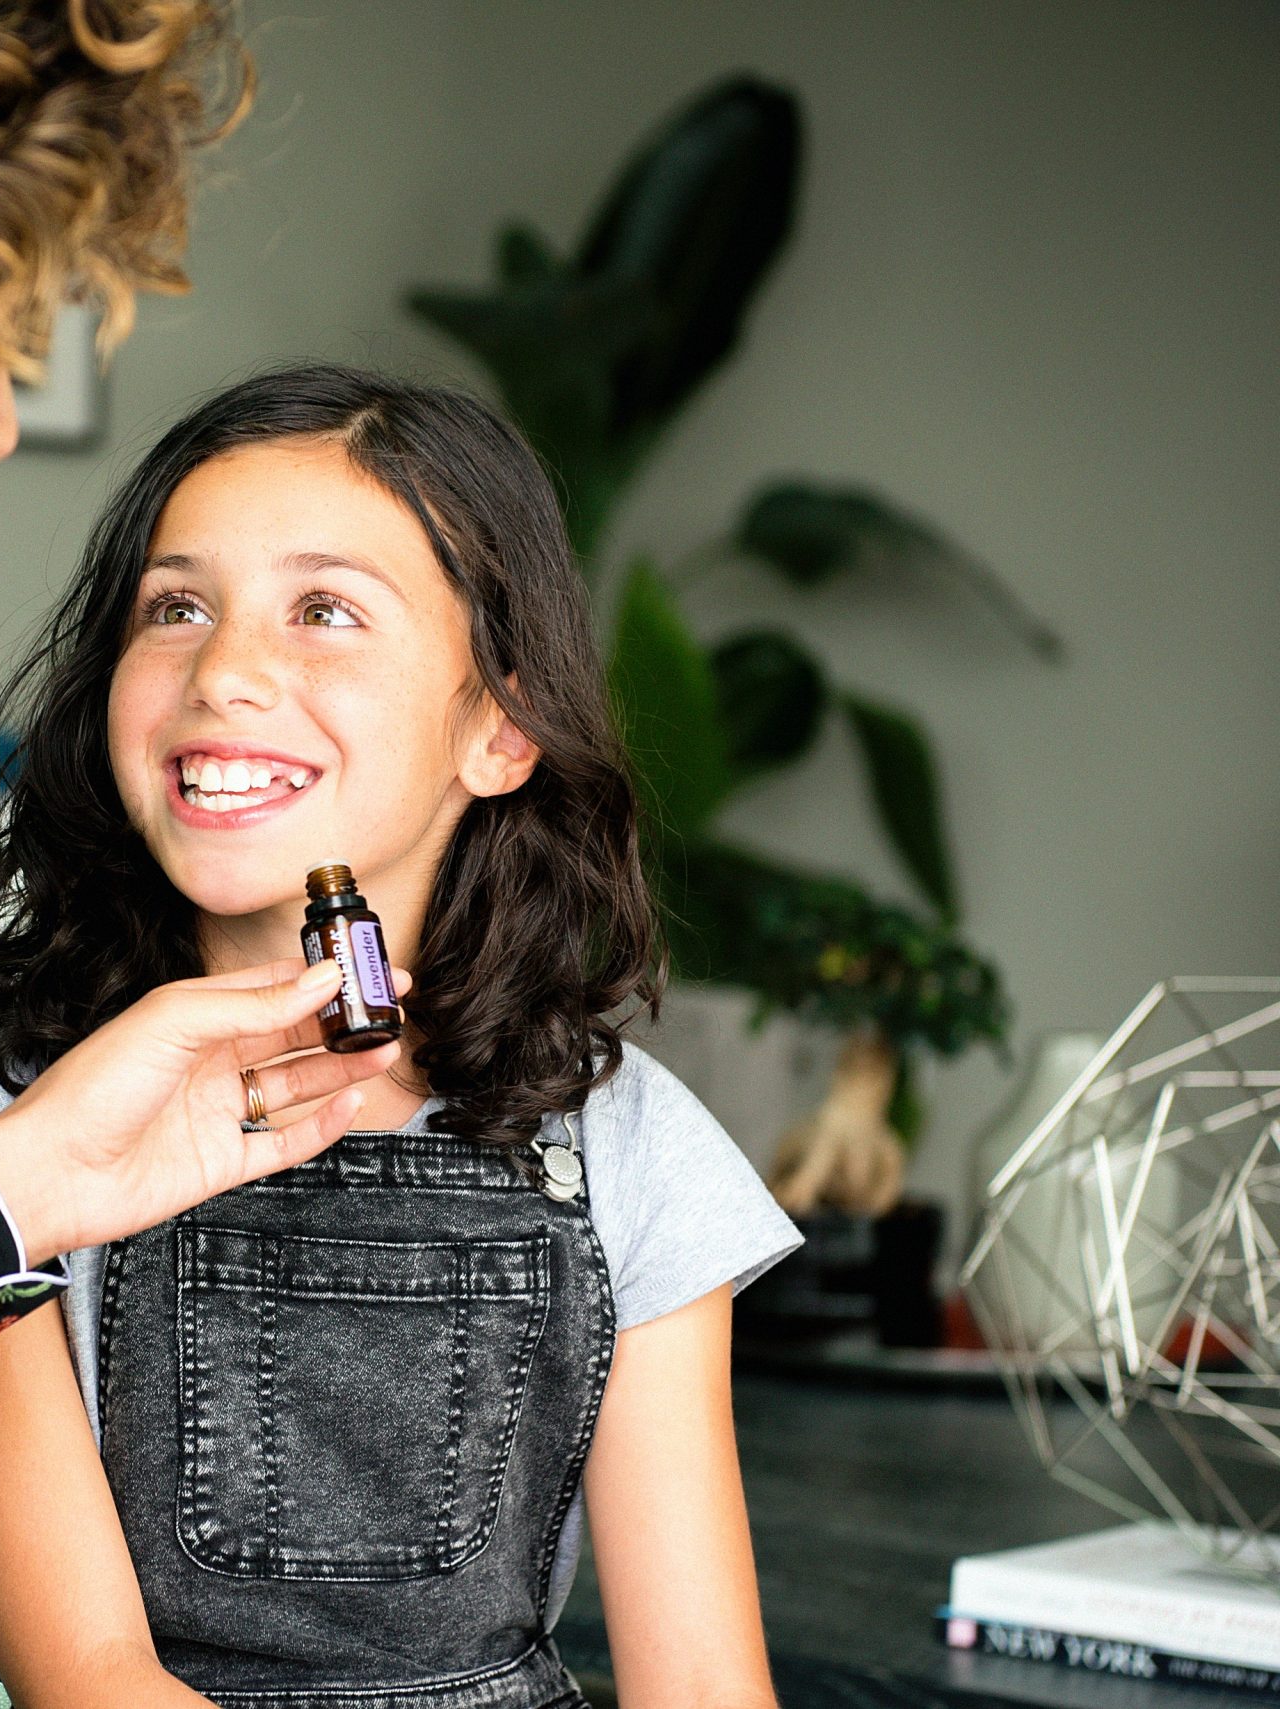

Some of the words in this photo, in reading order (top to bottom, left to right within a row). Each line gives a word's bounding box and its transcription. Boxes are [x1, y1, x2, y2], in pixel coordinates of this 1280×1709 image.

[362, 930, 384, 999] Lavender
[985, 1624, 1058, 1661] NEW
[1065, 1634, 1158, 1679] YORK
